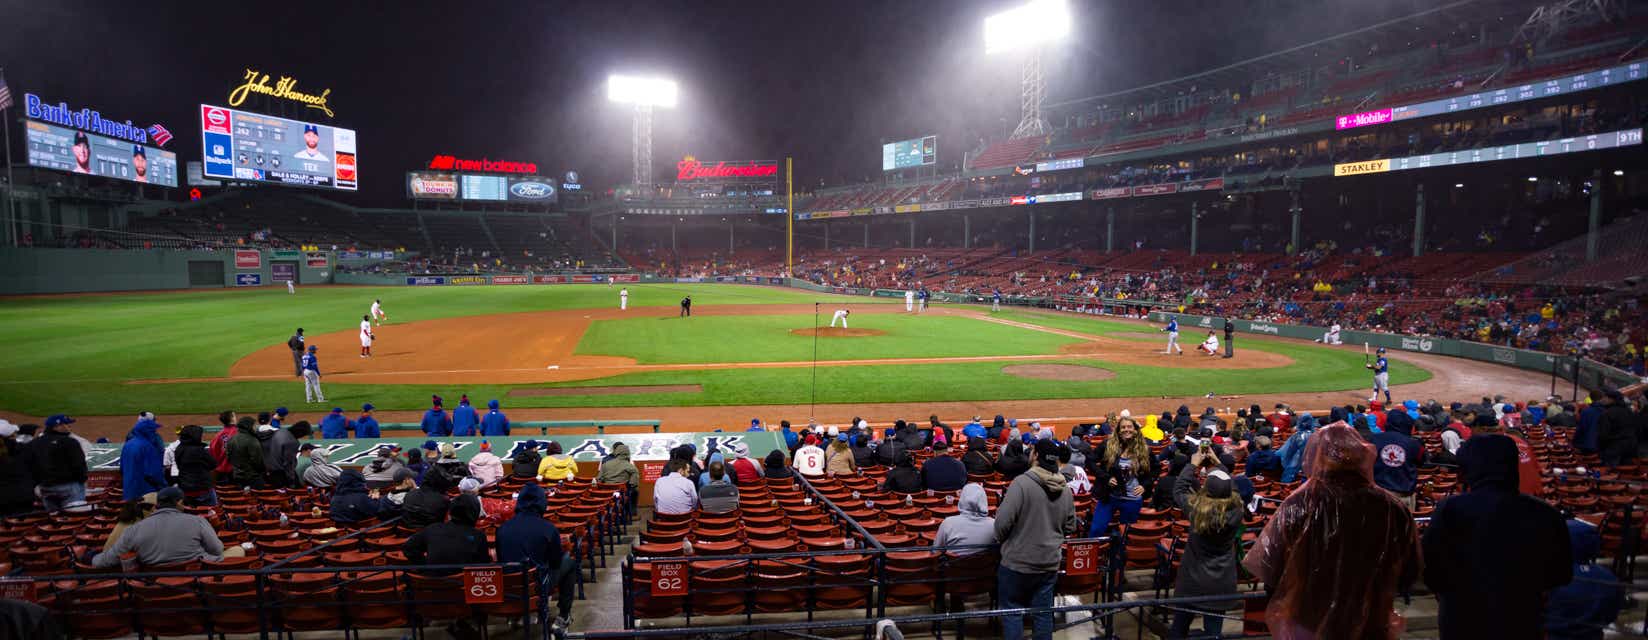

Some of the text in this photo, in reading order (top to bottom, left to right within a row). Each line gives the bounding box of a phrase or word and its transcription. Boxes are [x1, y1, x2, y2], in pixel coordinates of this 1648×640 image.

[229, 68, 335, 118] John Hancock
[24, 93, 74, 126] Bank
[74, 108, 90, 131] of
[91, 110, 147, 144] America
[1620, 132, 1641, 143] 9TH
[455, 157, 537, 173] new balance
[677, 160, 778, 180] Budweiser
[1340, 162, 1384, 175] STANLEY
[519, 183, 546, 196] Ford
[807, 455, 816, 468] 6
[657, 563, 683, 571] FIELD
[1072, 557, 1091, 569] 61
[660, 569, 680, 577] BOX
[657, 577, 682, 590] 62
[470, 584, 498, 597] 63
